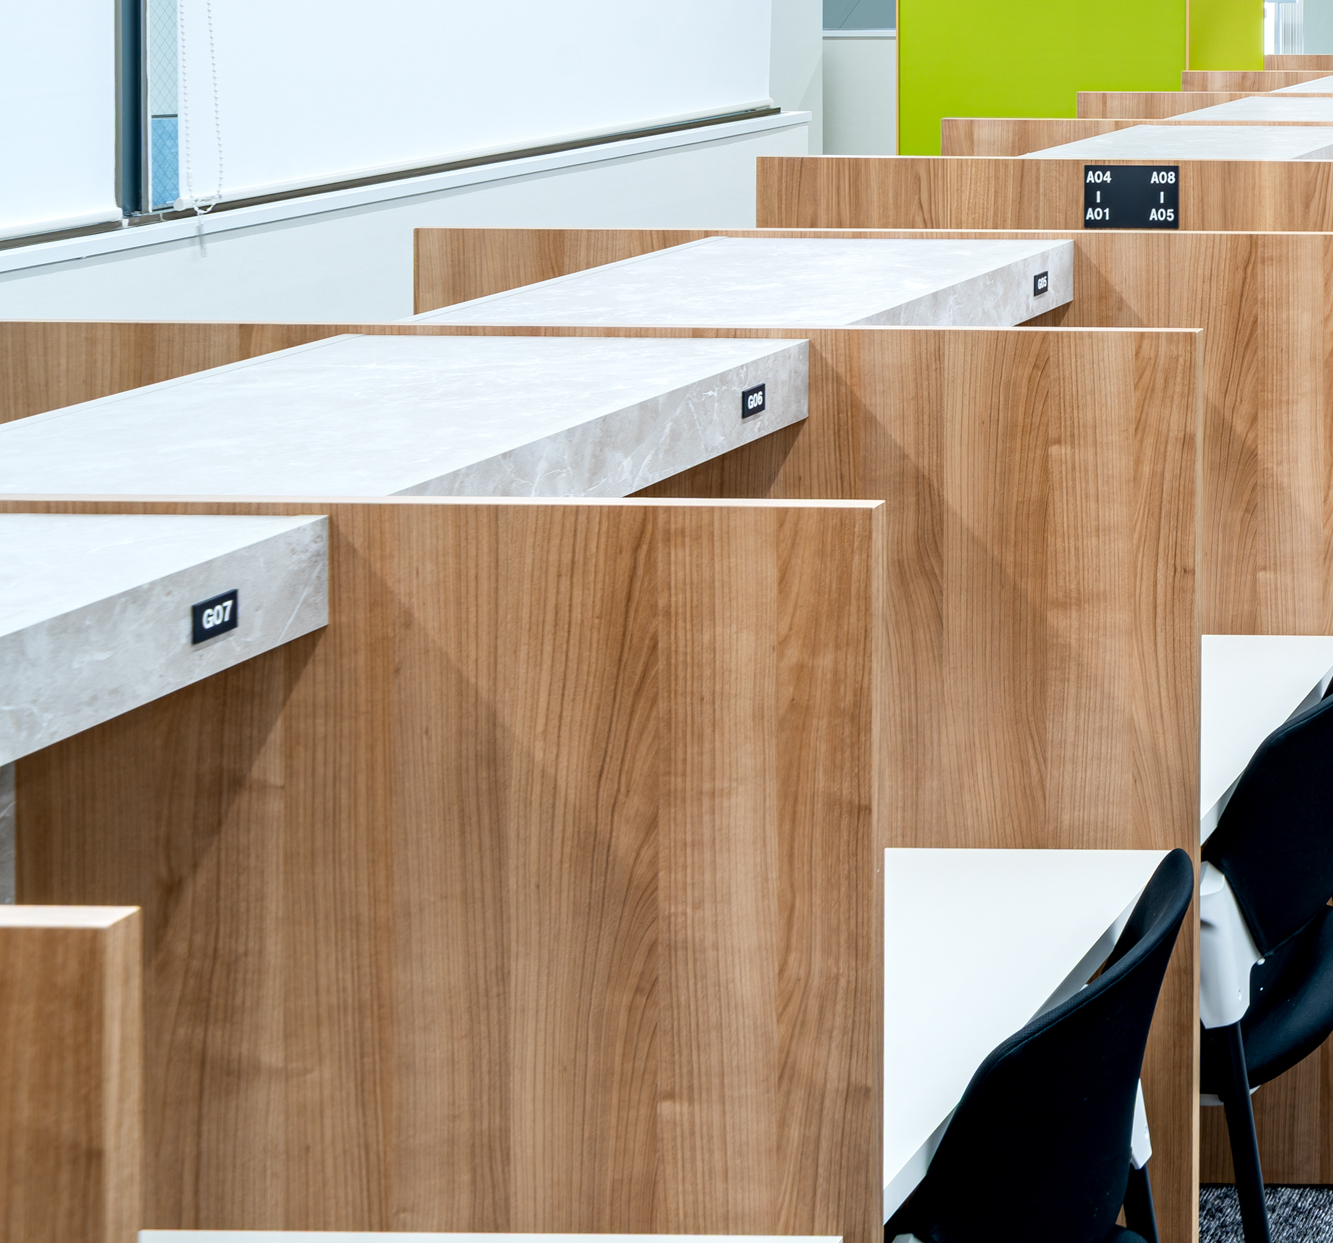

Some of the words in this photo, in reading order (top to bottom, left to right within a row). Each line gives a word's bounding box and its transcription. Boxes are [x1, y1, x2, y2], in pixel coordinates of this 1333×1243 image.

[1086, 170, 1112, 183] A04
[1150, 171, 1176, 184] A08
[1085, 207, 1110, 220] A01
[1149, 208, 1175, 221] A05
[747, 391, 763, 409] G06
[202, 600, 233, 629] G07
